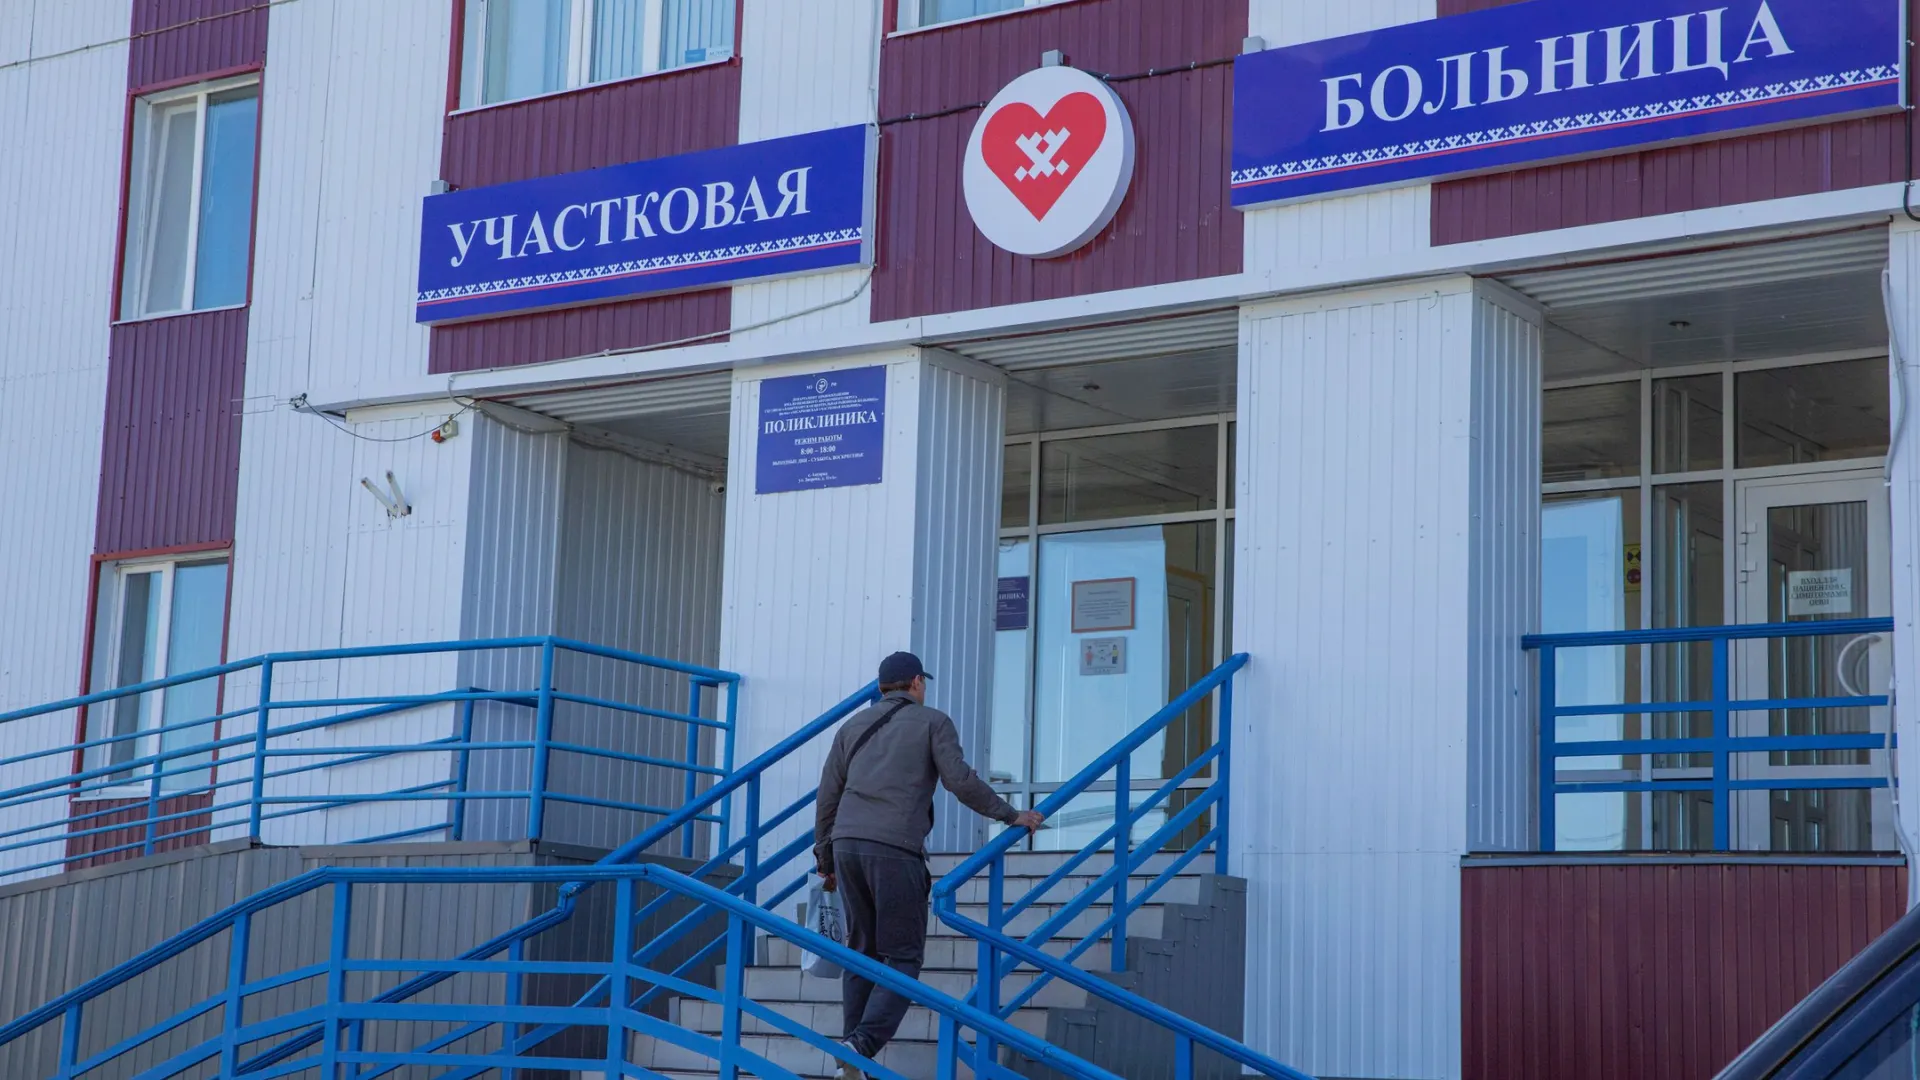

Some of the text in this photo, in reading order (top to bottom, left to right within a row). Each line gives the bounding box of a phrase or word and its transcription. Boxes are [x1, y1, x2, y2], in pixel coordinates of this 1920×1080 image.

[1319, 0, 1795, 133] БОЛЬНИЦА
[447, 166, 812, 268] УЧАСТКОВАЯ
[764, 410, 878, 434] ПОЛИКЛИНИКА
[794, 434, 843, 445] РЕЖИМ РАБОТЫ
[800, 447, 814, 455] 8:00
[820, 445, 836, 453] 18:00
